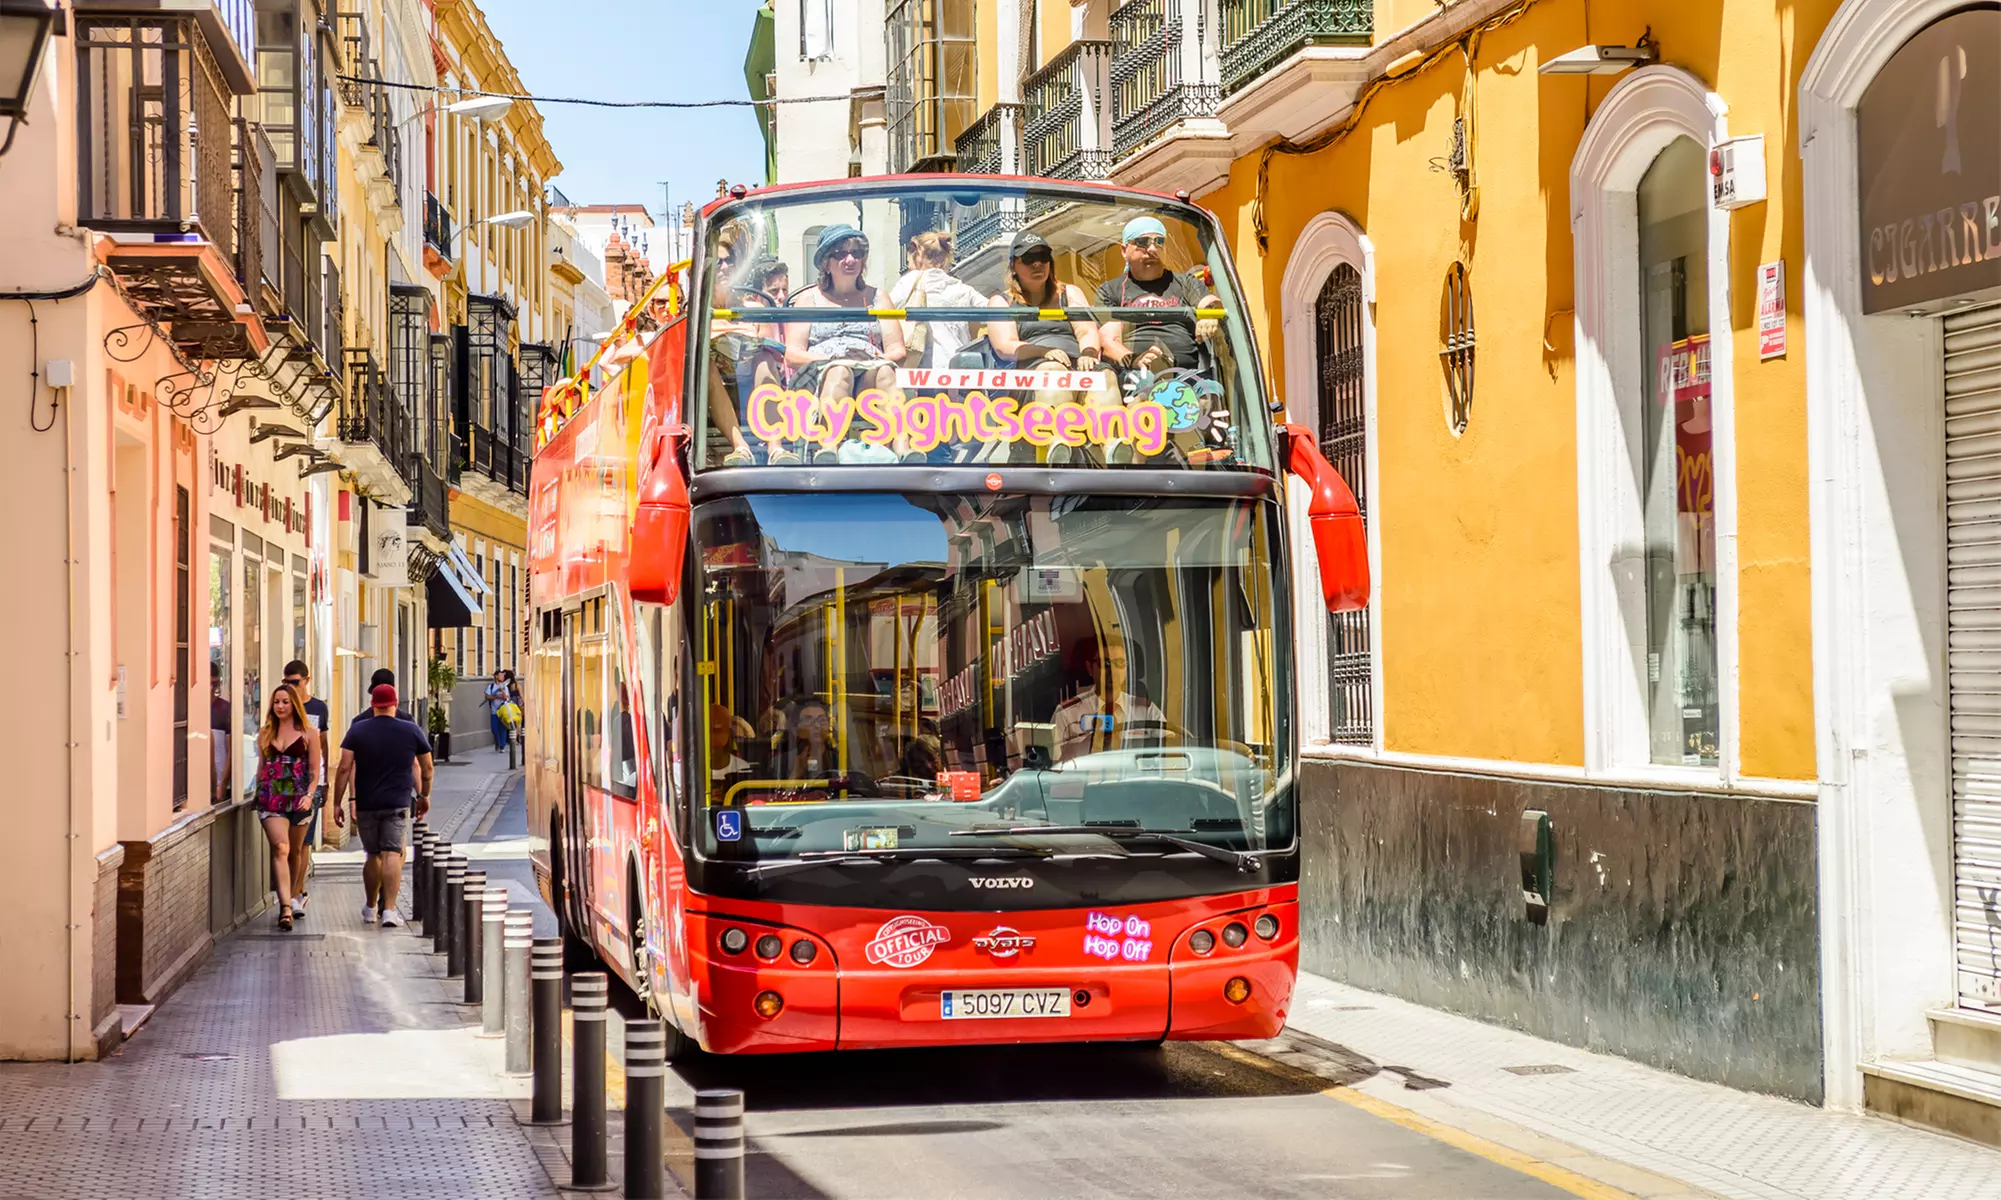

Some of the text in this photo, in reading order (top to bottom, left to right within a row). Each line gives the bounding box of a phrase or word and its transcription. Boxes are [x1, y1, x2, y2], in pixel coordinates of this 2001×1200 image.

[908, 370, 1094, 388] Worldwide
[747, 383, 1167, 457] City Sightseeing
[968, 877, 1034, 889] VOLVO
[1087, 911, 1151, 937] Hop On
[874, 928, 946, 958] OFFICIAL
[898, 946, 930, 963] TOUR
[1083, 934, 1153, 961] Hop Off
[963, 993, 1015, 1014] 5097
[1023, 992, 1062, 1014] CVZ
